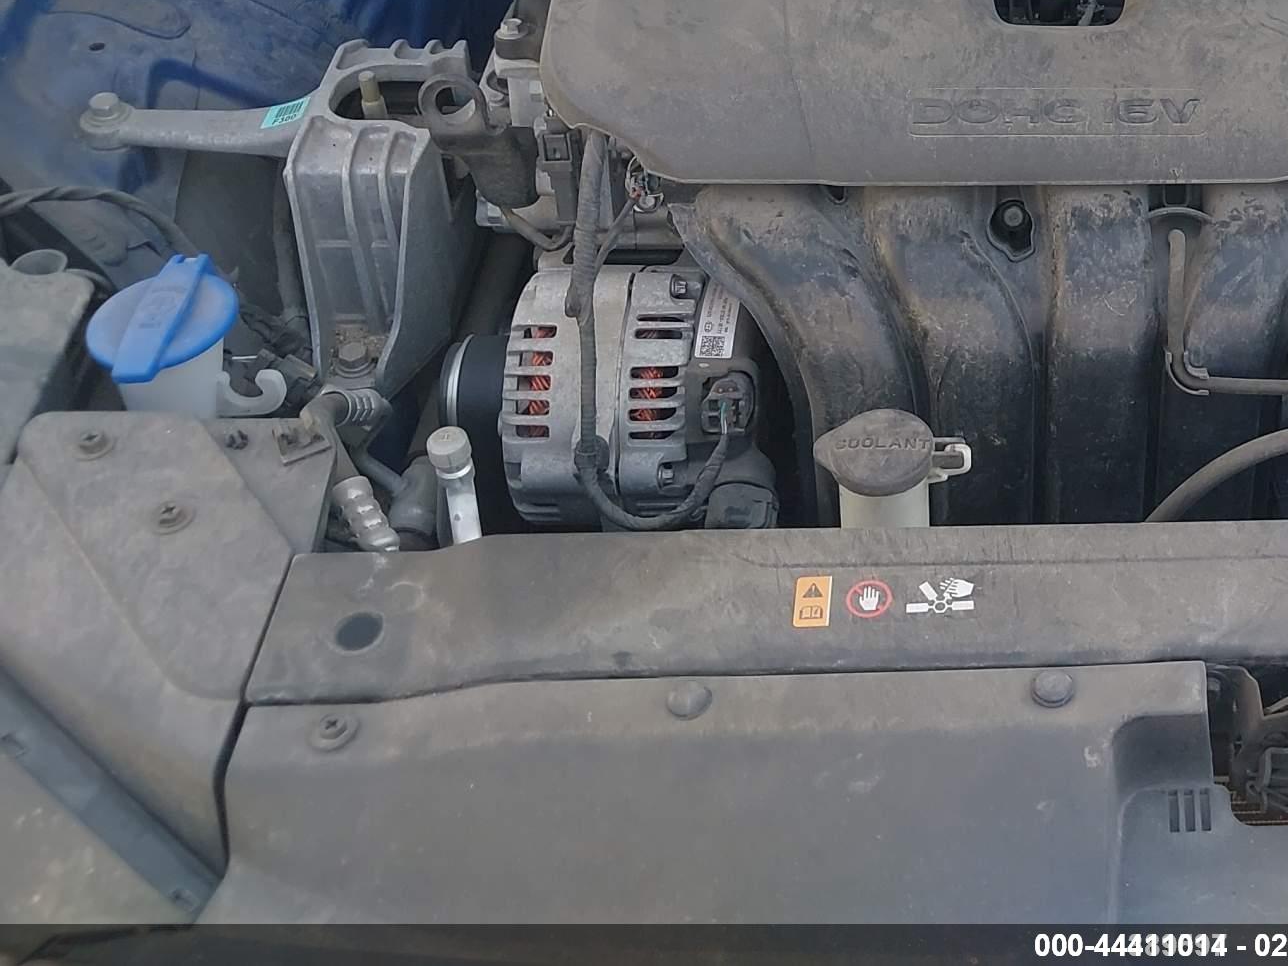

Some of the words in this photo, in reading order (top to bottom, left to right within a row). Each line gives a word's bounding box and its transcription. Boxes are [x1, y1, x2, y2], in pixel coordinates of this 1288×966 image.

[912, 98, 1089, 125] DOHC
[1104, 98, 1200, 125] 16V
[836, 437, 930, 450] COOLANT
